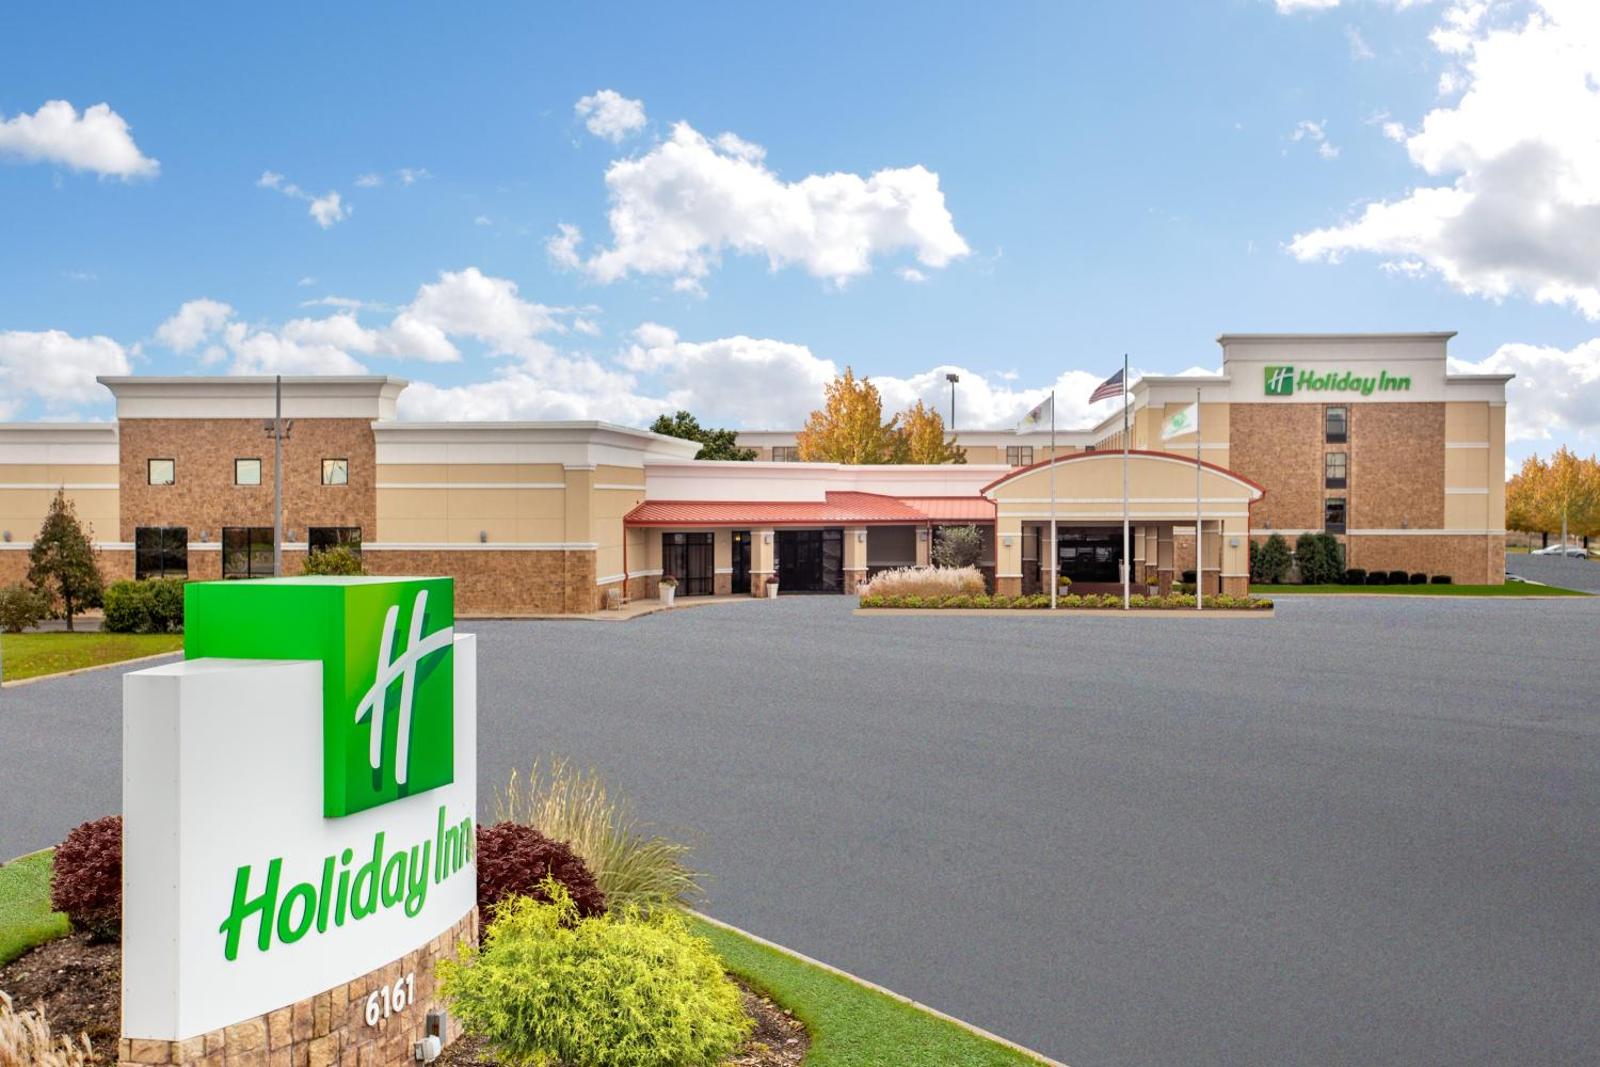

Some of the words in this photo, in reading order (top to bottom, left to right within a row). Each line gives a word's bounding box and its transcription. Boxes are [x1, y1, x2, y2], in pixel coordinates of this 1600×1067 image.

[1297, 370, 1375, 395] Holiday
[1379, 370, 1411, 391] Inn
[219, 831, 431, 961] Holiday
[435, 805, 473, 884] Inn
[365, 973, 415, 1026] 6161
